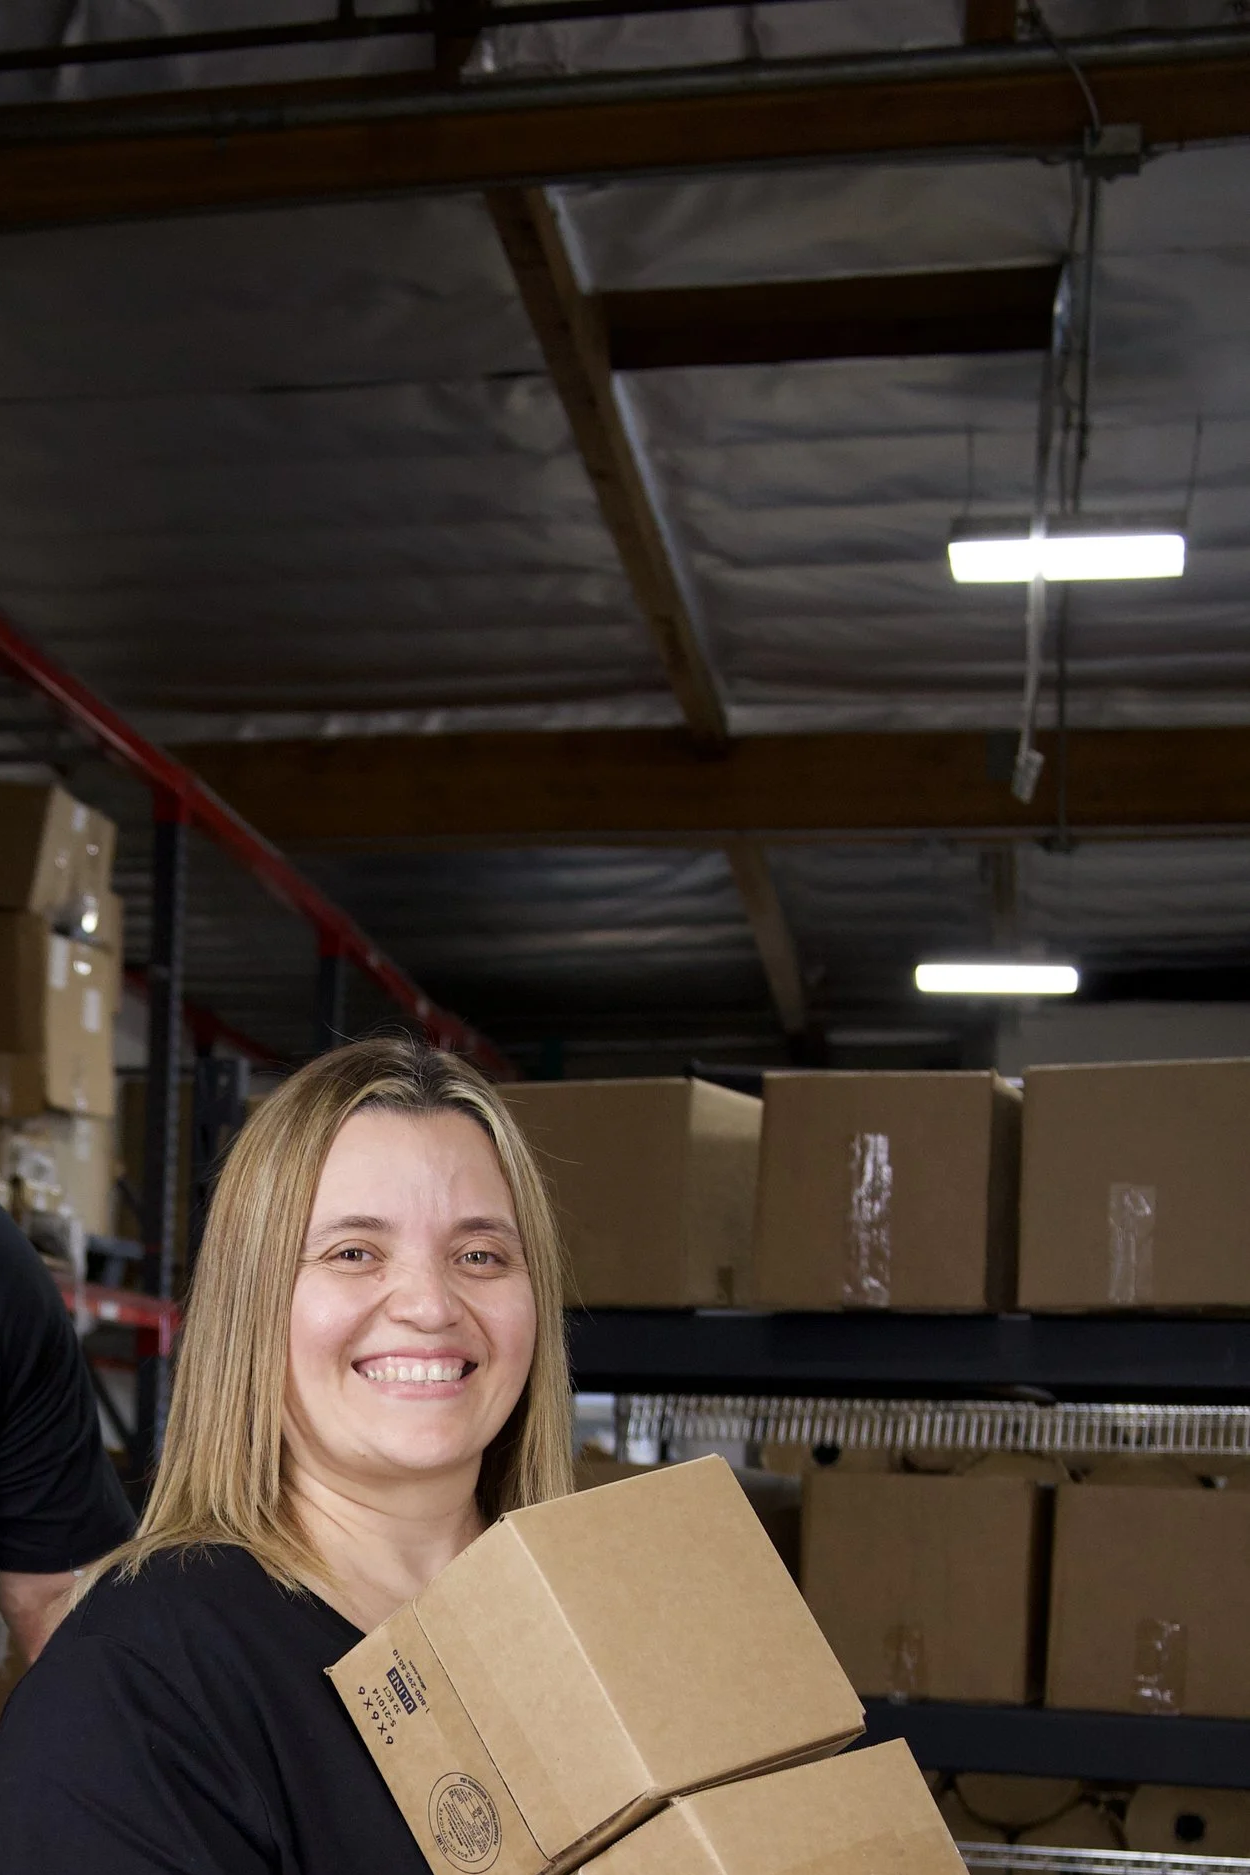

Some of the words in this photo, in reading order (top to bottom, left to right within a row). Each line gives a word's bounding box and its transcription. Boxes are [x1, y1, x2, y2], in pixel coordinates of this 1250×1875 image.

[392, 1649, 430, 1714] 1-800-295-5510
[358, 1686, 365, 1695] 6
[383, 1686, 395, 1703] ECT
[387, 1668, 416, 1713] ULINE
[372, 1688, 397, 1728] S-21014
[393, 1703, 401, 1715] 32
[371, 1711, 379, 1720] 6
[385, 1736, 394, 1745] 6
